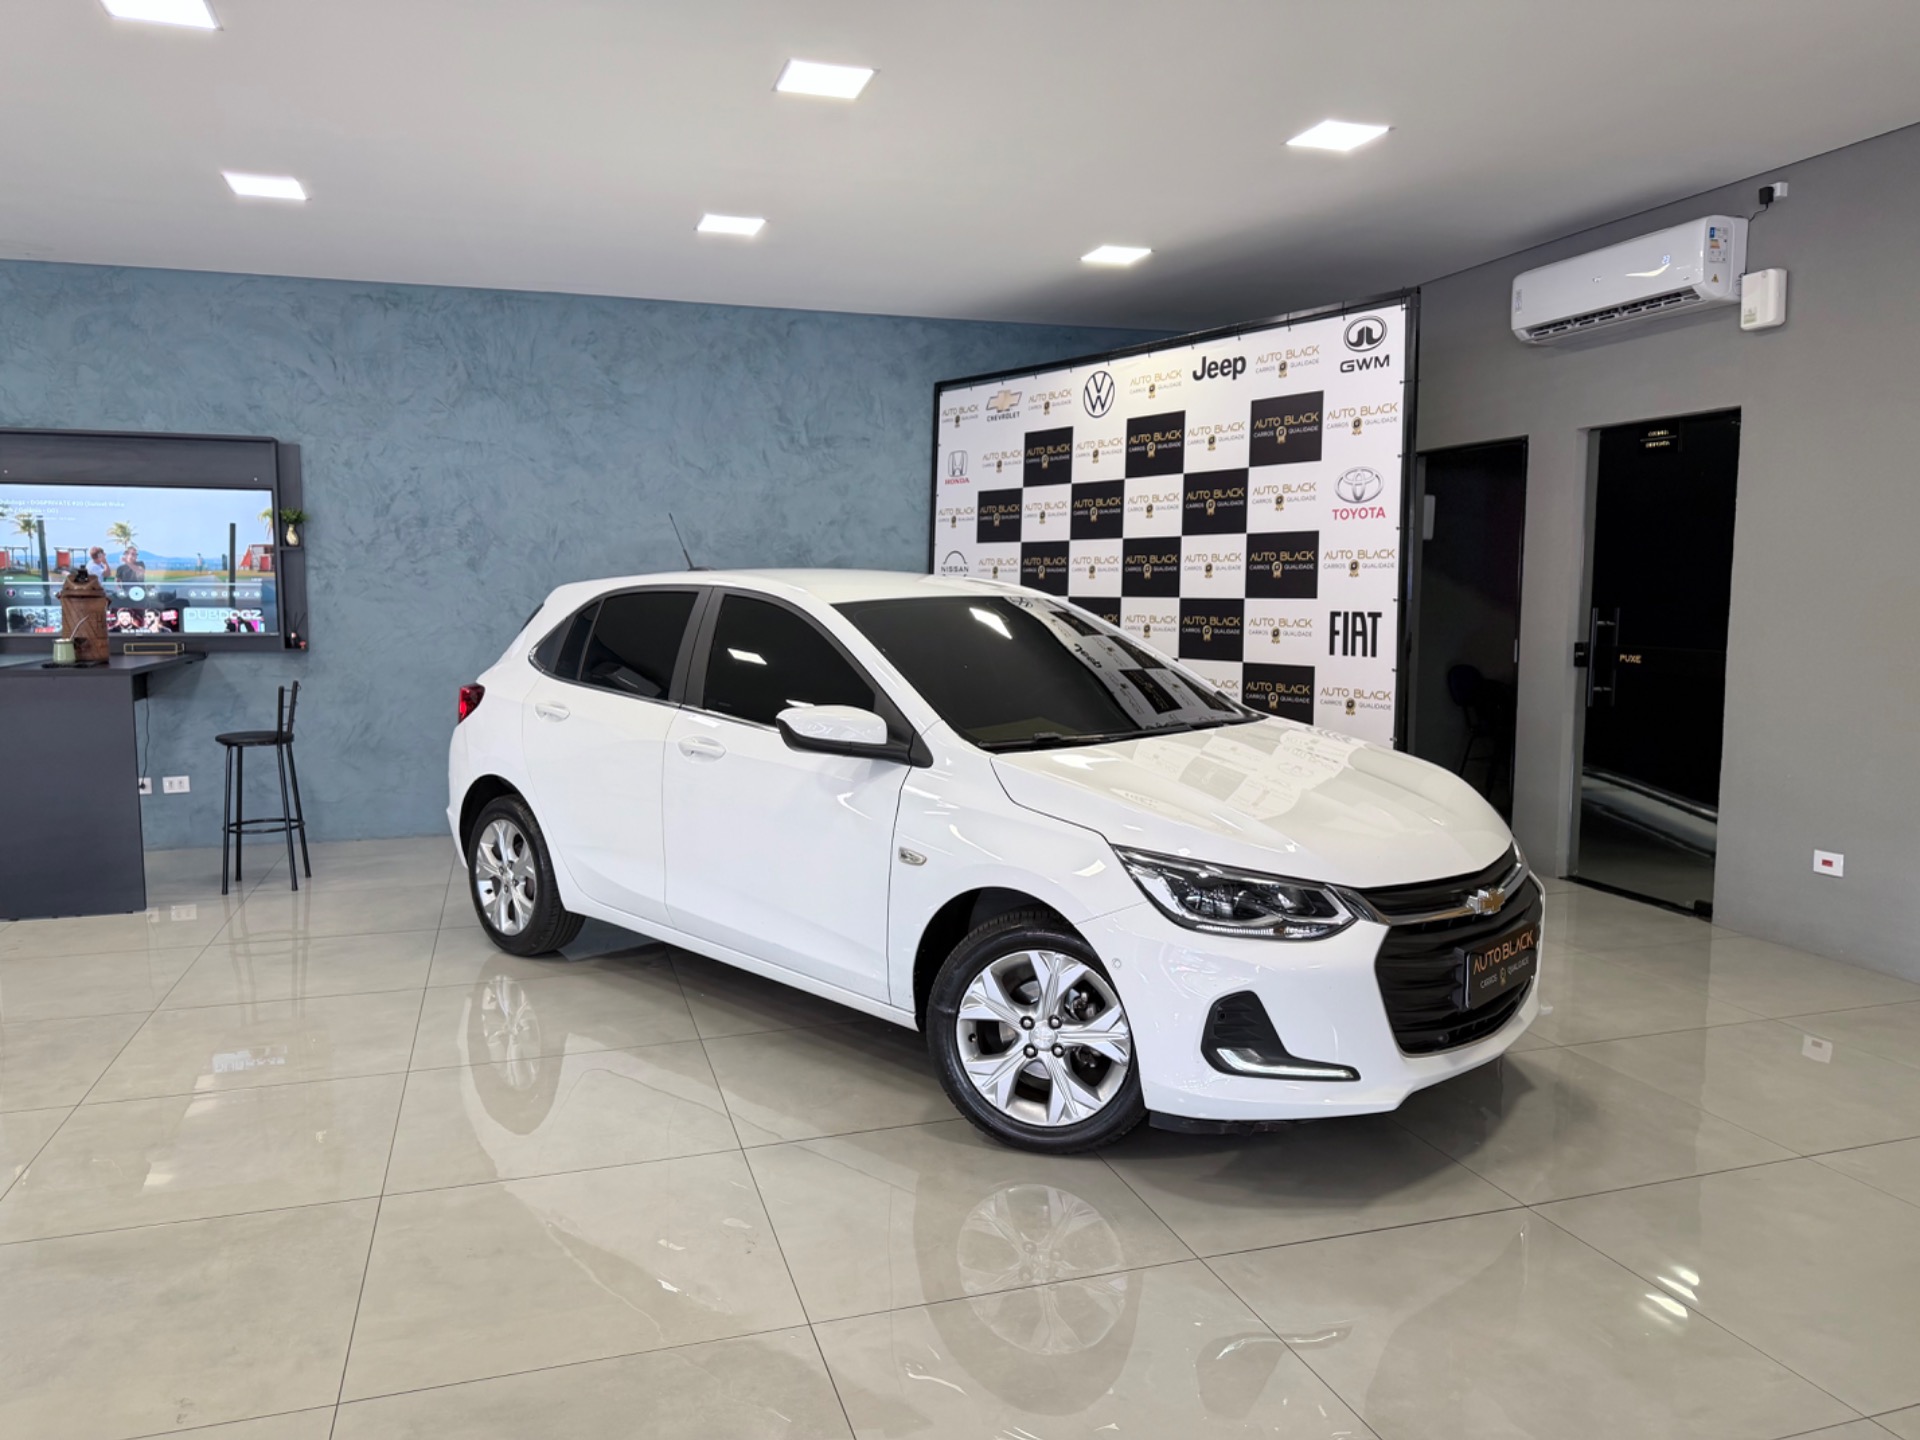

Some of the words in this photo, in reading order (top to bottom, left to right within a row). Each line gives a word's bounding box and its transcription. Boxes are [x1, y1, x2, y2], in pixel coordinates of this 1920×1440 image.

[1256, 352, 1281, 364] AUTO
[1286, 345, 1320, 359] BLACK
[1193, 356, 1246, 381] Jeep
[1340, 355, 1389, 373] GWM
[1130, 375, 1151, 386] AUTO
[1154, 370, 1182, 382] BLACK
[1029, 393, 1046, 403] AUTO
[1049, 389, 1072, 400] BLACK
[987, 411, 1020, 422] CHEVROLET
[1327, 408, 1356, 420] AUTO
[1361, 403, 1398, 416] BLACK
[1254, 418, 1280, 429] AUTO
[1284, 412, 1319, 425] BLACK
[1365, 417, 1397, 425] QUALIDADE
[1188, 426, 1210, 437] AUTO
[1214, 422, 1245, 434] BLACK
[1129, 433, 1151, 444] AUTO
[1154, 430, 1182, 441] BLACK
[1026, 447, 1044, 456] AUTO
[1047, 443, 1070, 453] BLACK
[1076, 440, 1095, 450] AUTO
[1098, 437, 1123, 448] BLACK
[1186, 490, 1210, 500] AUTO
[1213, 487, 1244, 499] BLACK
[1253, 485, 1279, 495] AUTO
[1283, 482, 1316, 493] BLACK
[1073, 499, 1093, 507] AUTO
[1096, 497, 1121, 507] BLACK
[1128, 495, 1149, 504] AUTO
[1152, 493, 1180, 502] BLACK
[1332, 507, 1385, 520] TOYOTA
[1094, 556, 1119, 564] BLACK
[1125, 556, 1147, 564] AUTO
[1150, 554, 1177, 563] BLACK
[1185, 554, 1208, 562] AUTO
[1211, 553, 1241, 562] BLACK
[1250, 552, 1276, 561] AUTO
[1280, 551, 1314, 561] BLACK
[1324, 550, 1353, 560] AUTO
[1358, 549, 1395, 559] BLACK
[1043, 557, 1066, 565] BLACK
[186, 609, 262, 620] DUBDOGZ
[1125, 615, 1146, 623] AUTO
[1149, 614, 1176, 623] BLACK
[1183, 616, 1206, 624] AUTO
[1209, 616, 1240, 626] BLACK
[1249, 618, 1275, 626] AUTO
[1279, 618, 1312, 628] BLACK
[1329, 611, 1382, 657] FIAT
[1620, 654, 1642, 664] PUXE
[1246, 682, 1272, 691] AUTO
[1276, 683, 1310, 694] BLACK
[1320, 687, 1349, 698] AUTO
[1354, 689, 1391, 700] BLACK
[1358, 702, 1391, 710] QUALIDADE
[1473, 947, 1501, 975] AUTO
[1502, 930, 1533, 960] BLACK
